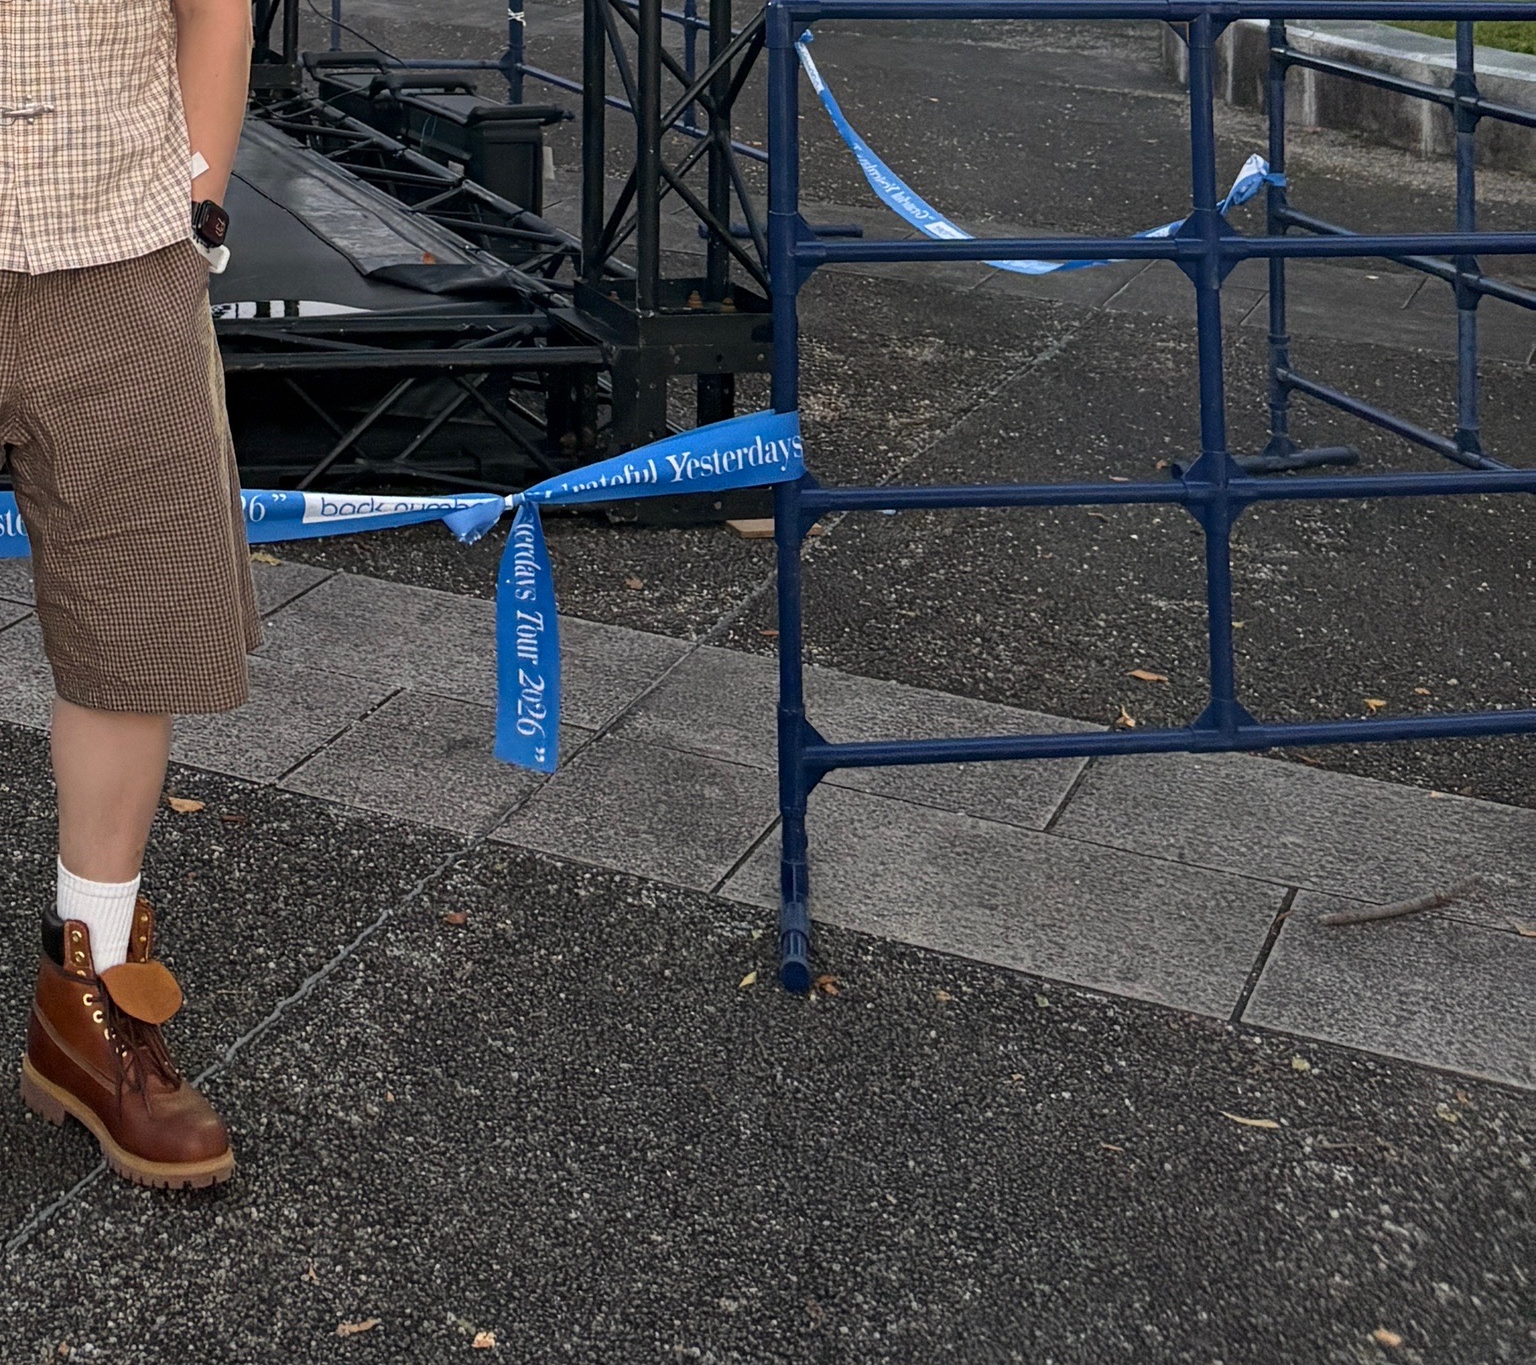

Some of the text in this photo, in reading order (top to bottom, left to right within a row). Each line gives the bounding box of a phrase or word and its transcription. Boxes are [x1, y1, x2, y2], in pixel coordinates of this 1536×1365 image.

[665, 434, 803, 483] Yesterdays
[516, 610, 545, 665] Tour
[516, 668, 547, 738] 2026
